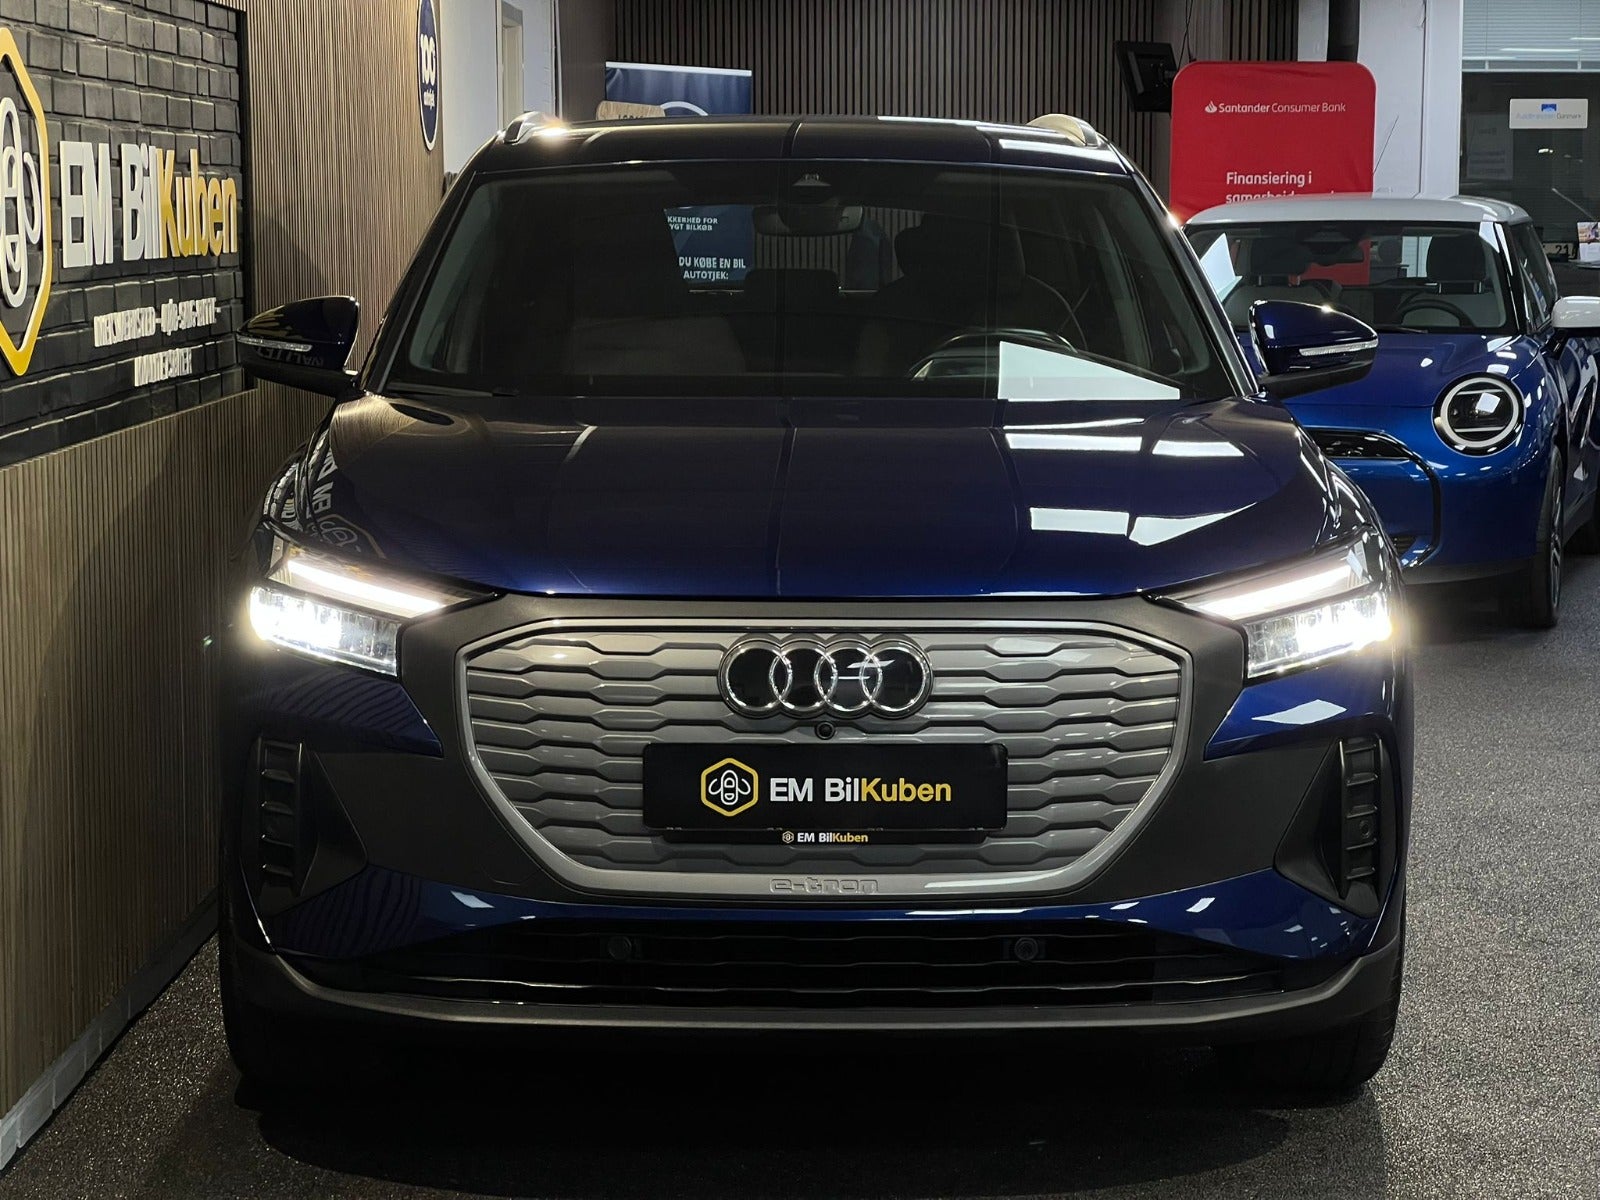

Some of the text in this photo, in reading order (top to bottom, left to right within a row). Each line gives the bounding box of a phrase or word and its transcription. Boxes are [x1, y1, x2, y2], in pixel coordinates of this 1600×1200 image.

[1218, 102, 1346, 113] Santander Consumer Bank
[1226, 170, 1312, 187] Finansiering i
[60, 141, 237, 267] EM BilKuben
[679, 257, 746, 269] DU KØBE EN BIL
[683, 271, 729, 281] AUTOTJEK:
[770, 777, 951, 802] EM BilKuben
[797, 832, 868, 842] EM BilKuben
[770, 876, 878, 894] e-tron
